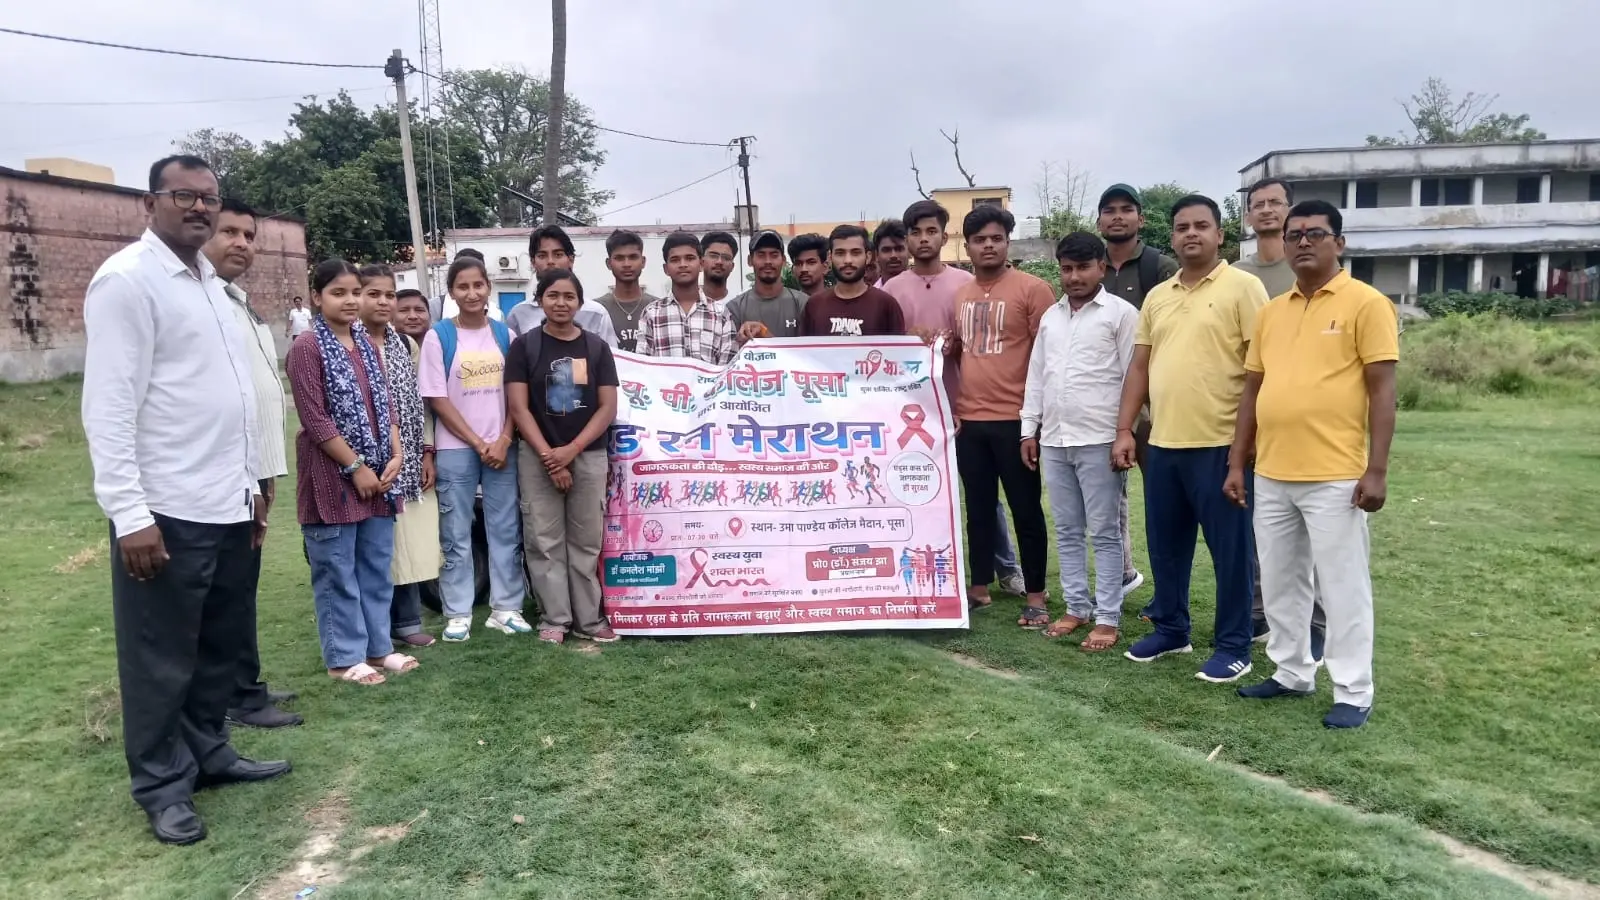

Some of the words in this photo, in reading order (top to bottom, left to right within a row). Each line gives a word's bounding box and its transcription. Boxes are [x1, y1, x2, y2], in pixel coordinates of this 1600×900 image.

[744, 350, 777, 361] योजना
[791, 370, 848, 400] पूसा
[720, 400, 771, 412] आयोजित
[727, 414, 886, 453] मेराथन
[765, 463, 795, 472] समाज
[751, 522, 777, 532] स्थान-
[779, 522, 794, 533] उमा
[796, 519, 826, 532] पाण्डेय
[828, 516, 857, 530] कॉलेज
[859, 516, 885, 530] मैदान,
[887, 518, 905, 531] पूसा
[742, 552, 763, 563] युवा
[852, 557, 873, 566] संजय
[619, 564, 645, 575] कमलेश
[737, 566, 765, 575] भारत
[614, 611, 643, 624] मिलकर
[670, 611, 678, 623] के
[681, 610, 699, 623] प्रति
[785, 602, 804, 619] और
[808, 608, 832, 619] स्वस्थ
[836, 606, 865, 617] समाज
[869, 605, 882, 615] का
[885, 602, 917, 615] निर्माण
[920, 601, 936, 614] करें
